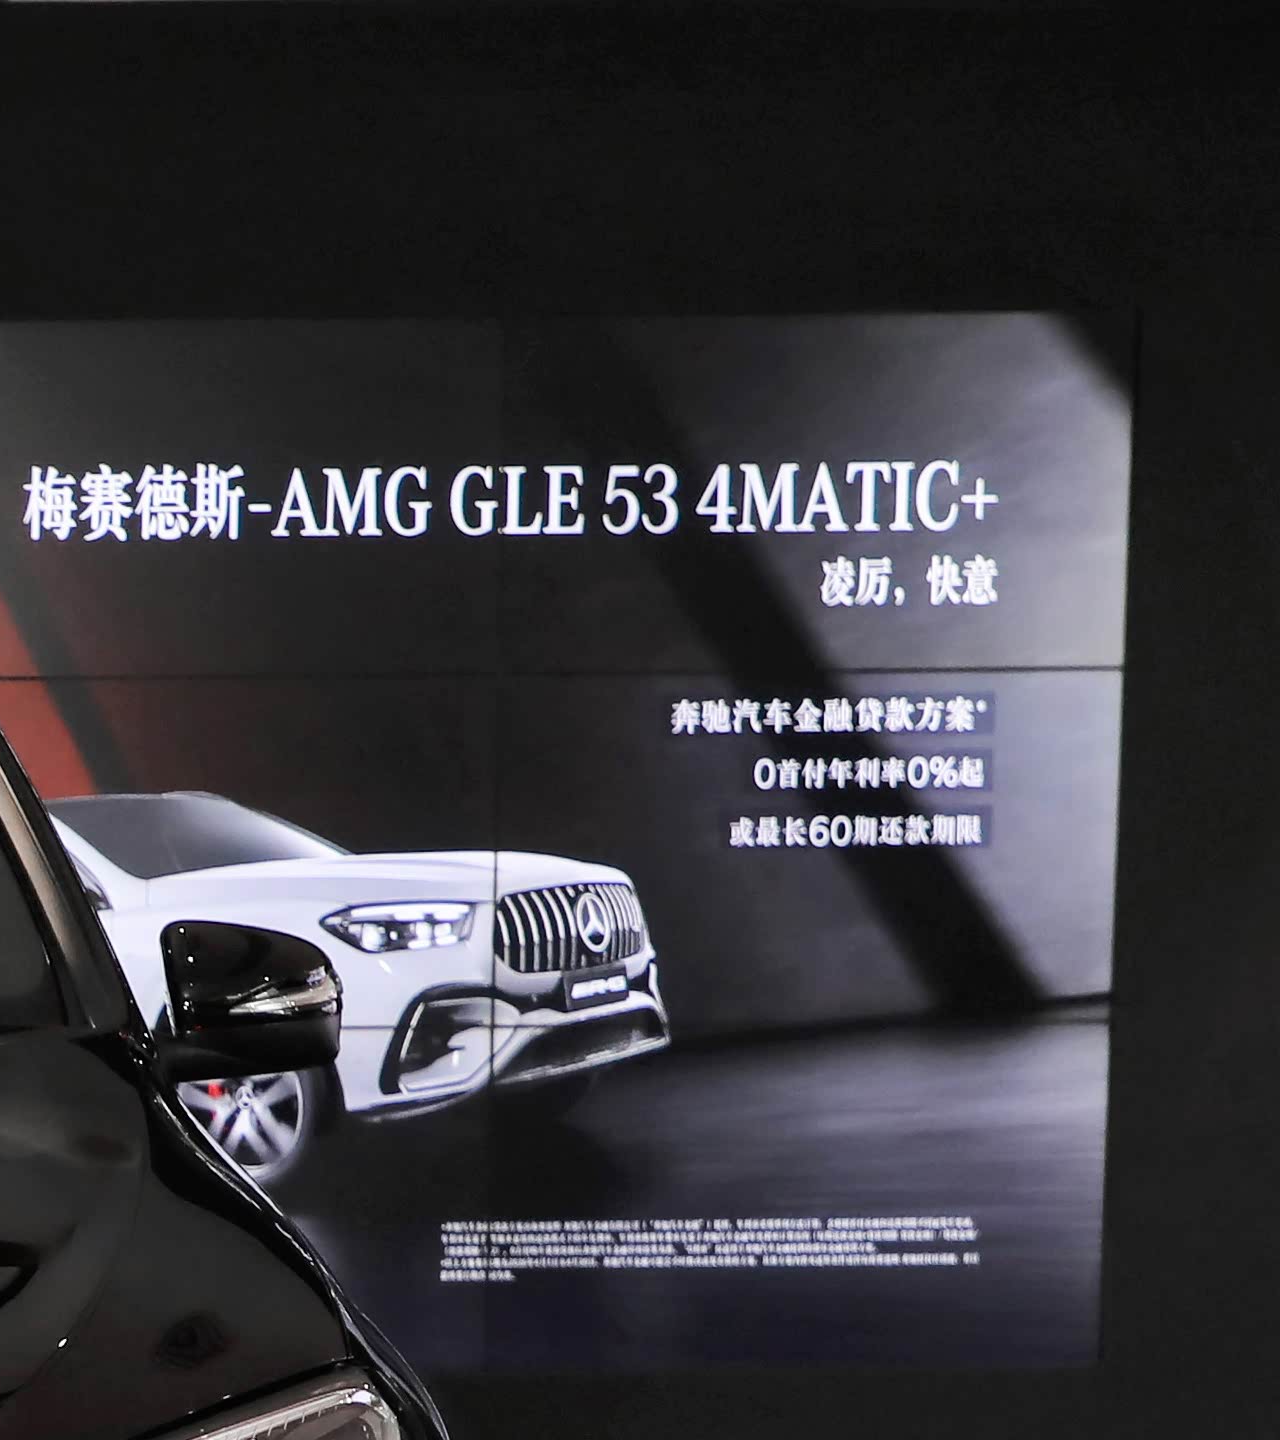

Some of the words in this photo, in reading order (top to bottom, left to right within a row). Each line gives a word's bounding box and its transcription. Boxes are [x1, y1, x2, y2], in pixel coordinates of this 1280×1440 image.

[22, 463, 432, 541] 梅赛德斯-AMG
[449, 464, 584, 537] GLE
[601, 463, 679, 535] 53
[695, 459, 999, 534] 4MATIC+
